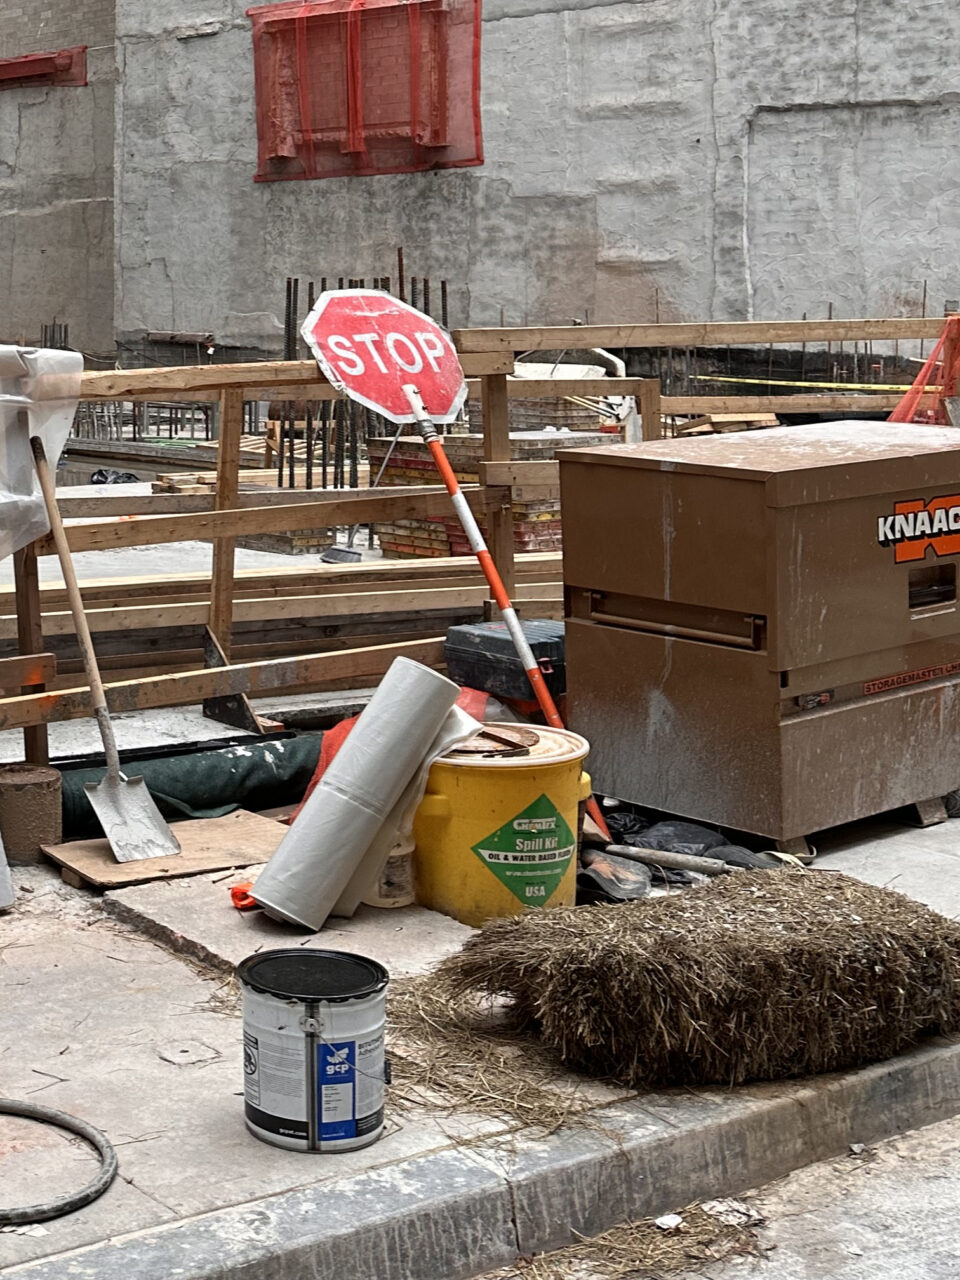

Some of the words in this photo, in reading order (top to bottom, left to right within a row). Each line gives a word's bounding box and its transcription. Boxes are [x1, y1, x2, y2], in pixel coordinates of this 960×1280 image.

[327, 332, 445, 376] STOP
[865, 667, 945, 693] STORAGEMASTER
[515, 837, 543, 852] Spill
[545, 836, 558, 849] Kit
[488, 853, 501, 861] OIL
[512, 854, 537, 862] WATER
[525, 886, 546, 897] USA
[325, 1064, 349, 1074] gcp
